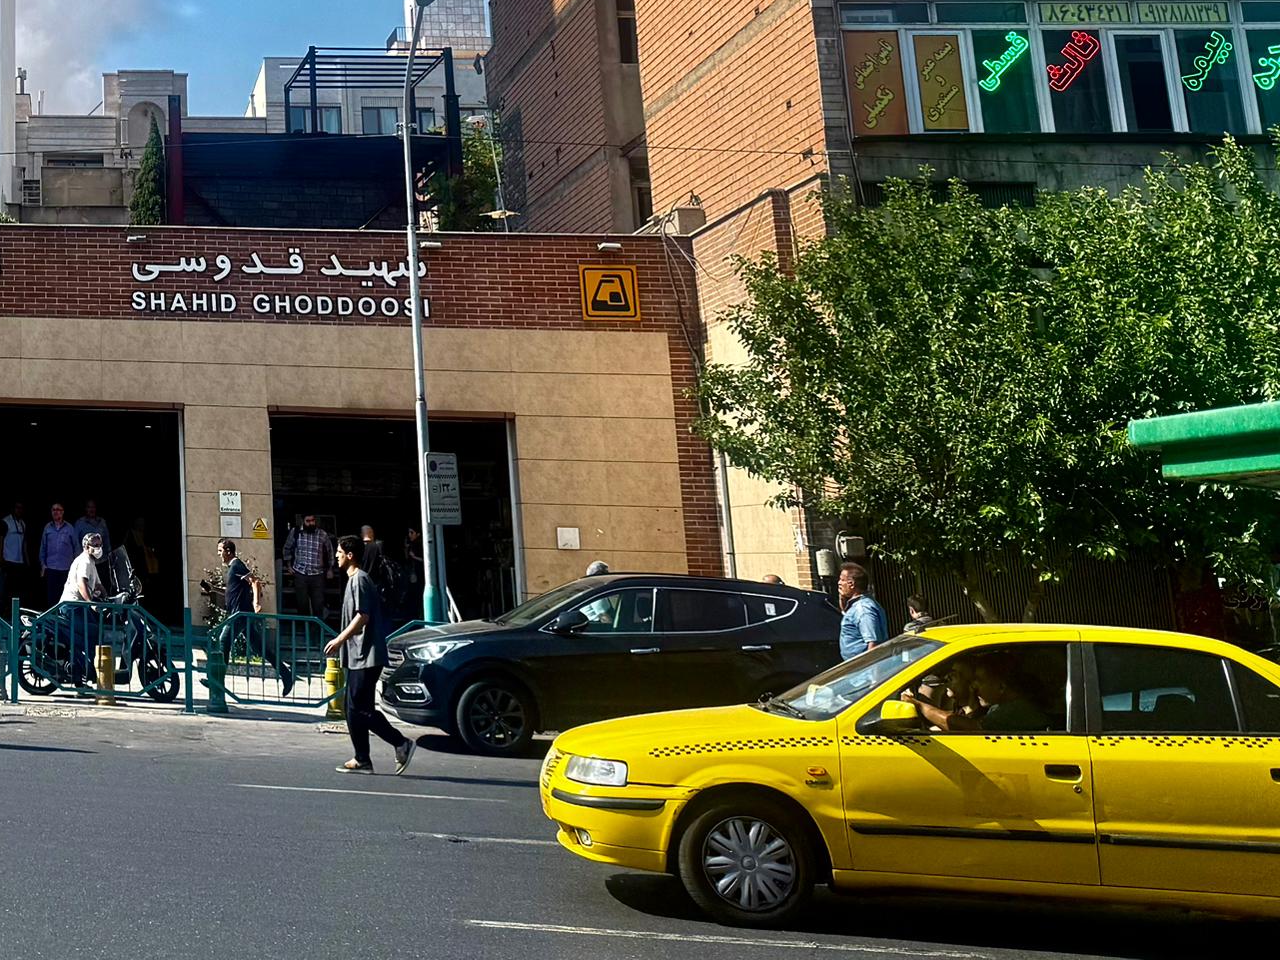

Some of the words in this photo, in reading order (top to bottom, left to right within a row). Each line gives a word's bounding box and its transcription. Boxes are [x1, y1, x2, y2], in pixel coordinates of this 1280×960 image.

[979, 31, 1029, 92] قسطی
[1046, 30, 1100, 92] ثالث
[1181, 30, 1233, 91] بیمه
[131, 291, 238, 313] SHAHID
